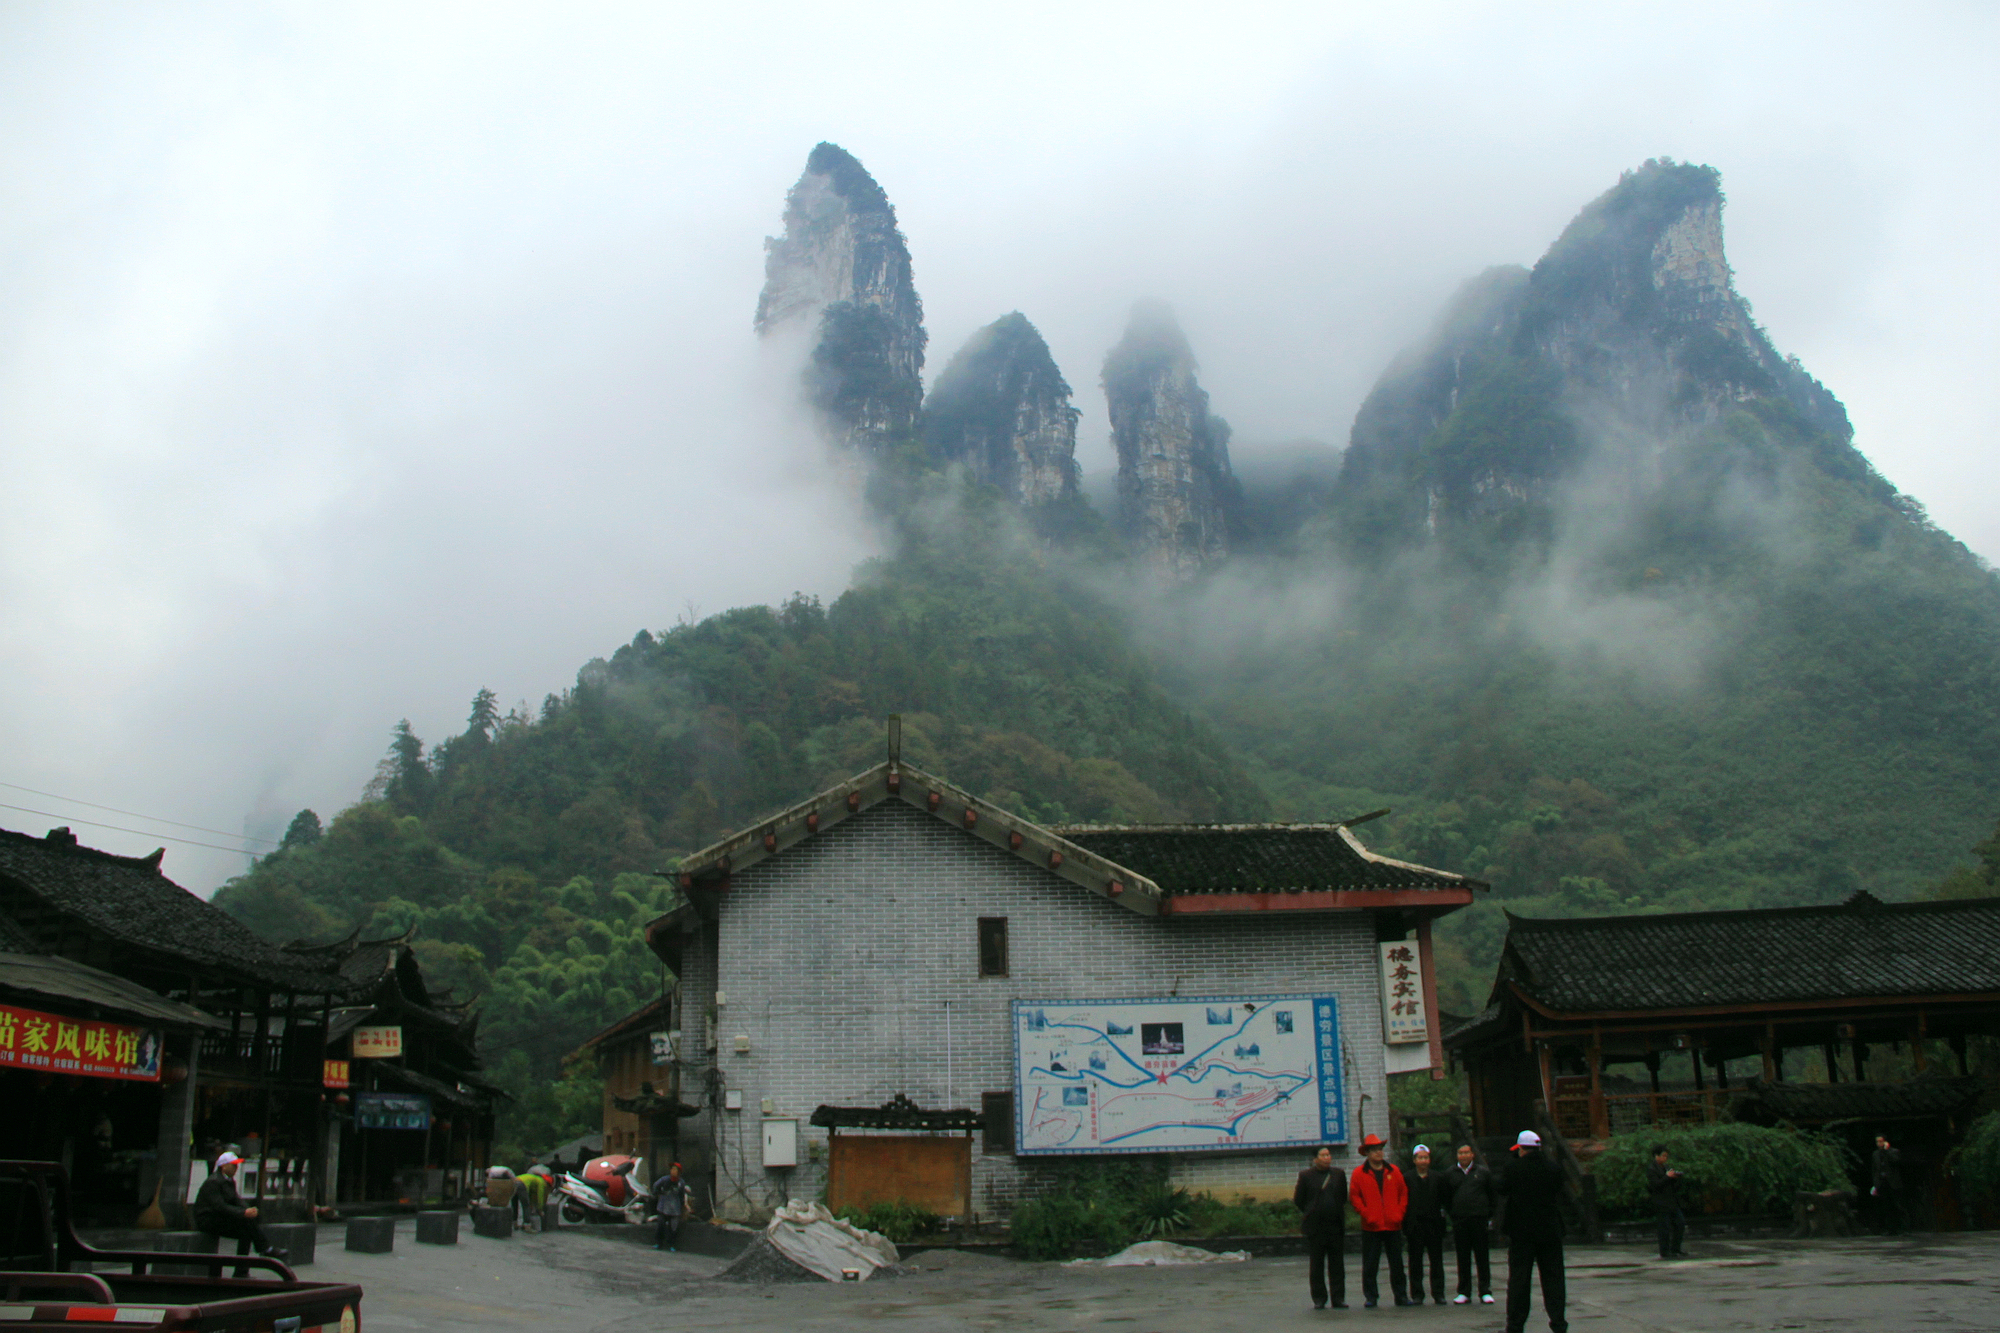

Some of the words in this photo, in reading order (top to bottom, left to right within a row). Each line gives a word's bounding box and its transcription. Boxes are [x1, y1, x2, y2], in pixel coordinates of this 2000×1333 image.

[1387, 945, 1420, 1016] 德夯宾馆
[0, 1011, 141, 1065] 苗家风味馆
[1318, 1004, 1339, 1135] 德夯景区景点导游图
